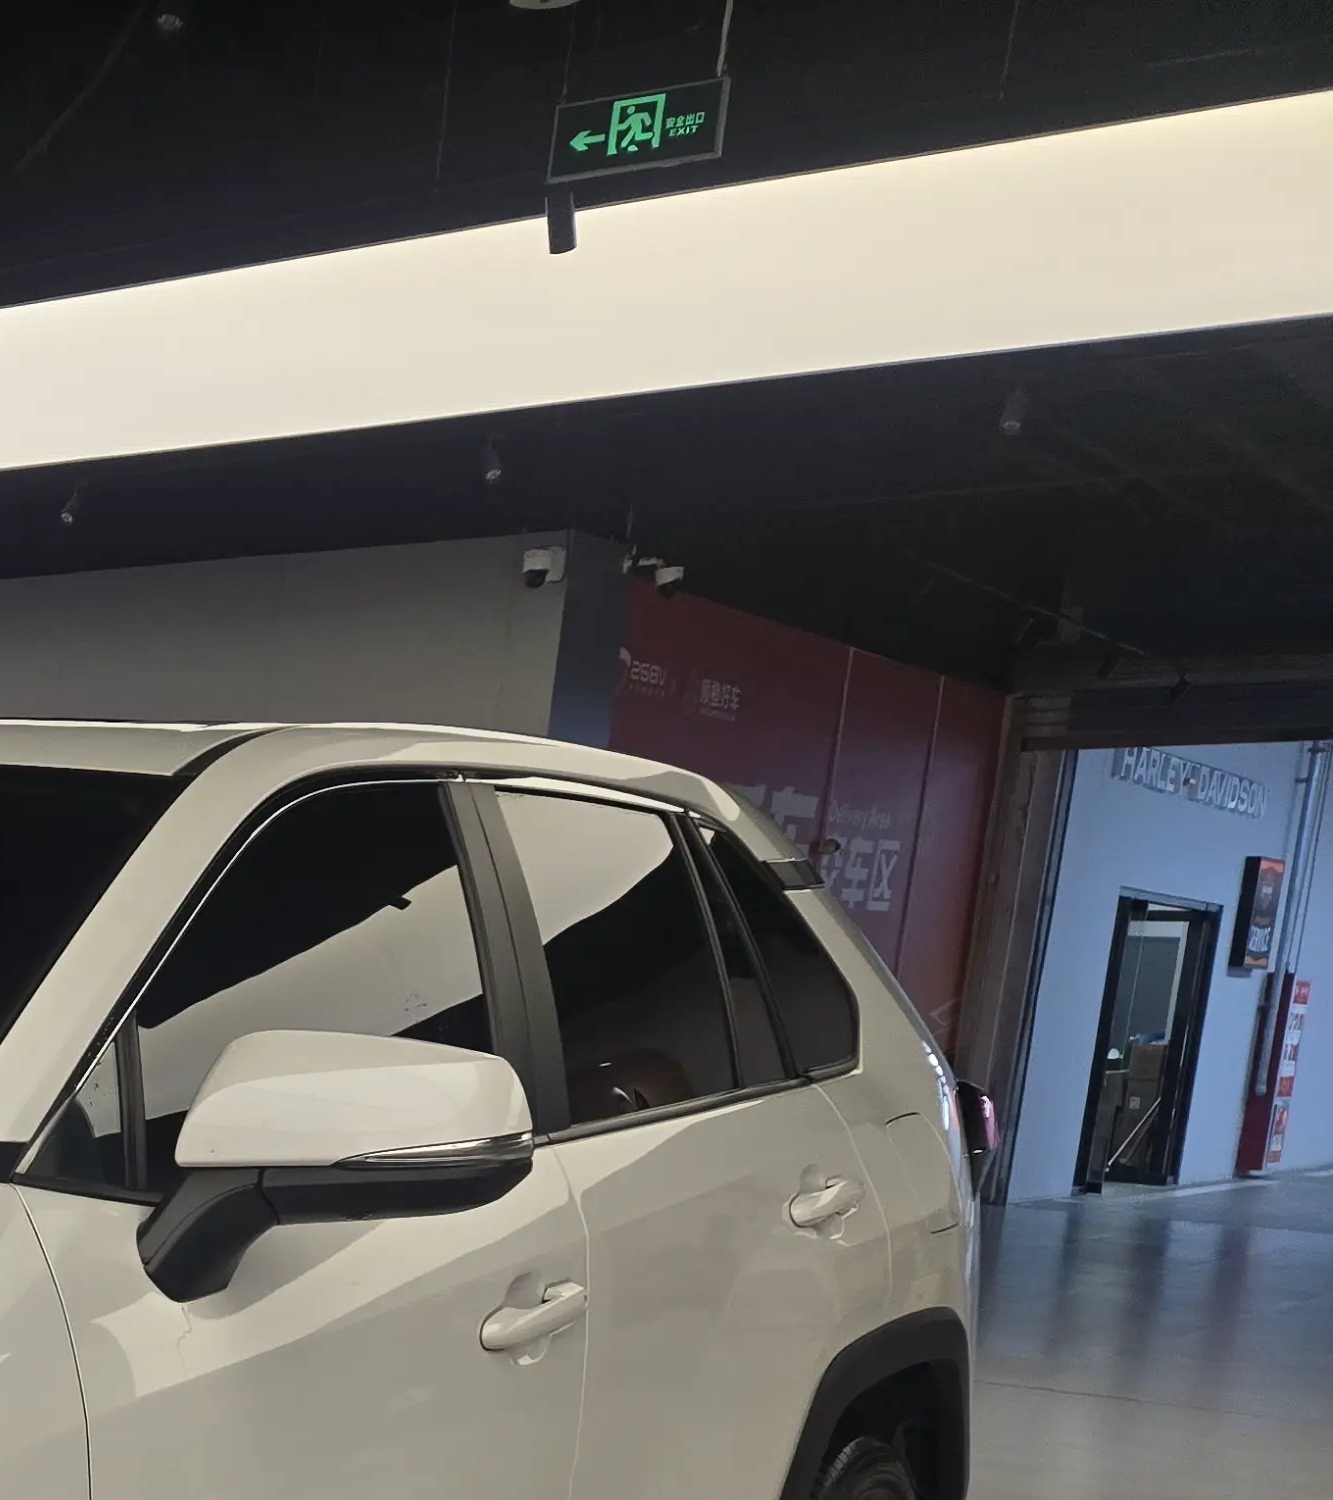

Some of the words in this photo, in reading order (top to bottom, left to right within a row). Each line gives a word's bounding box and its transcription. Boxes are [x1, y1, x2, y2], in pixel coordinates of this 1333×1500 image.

[665, 111, 705, 129] 安全出口
[669, 125, 699, 137] EXIT
[1120, 747, 1268, 819] HARLEY-DAVIDSON
